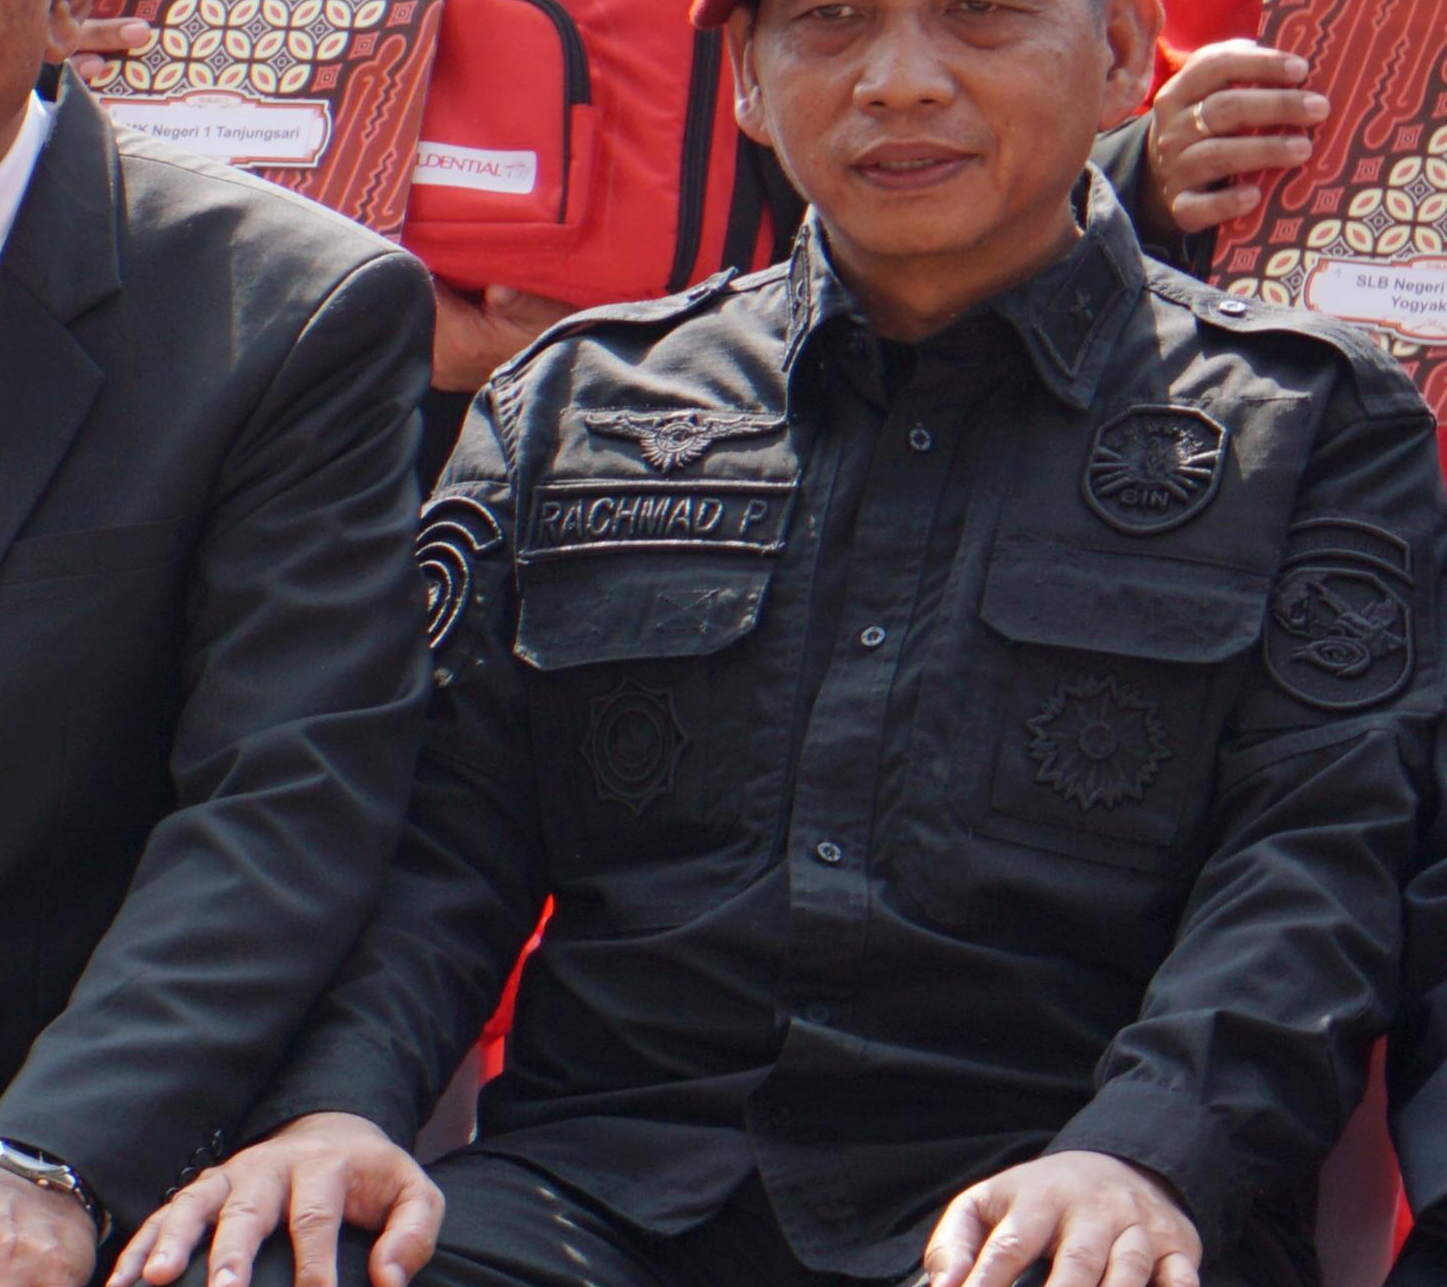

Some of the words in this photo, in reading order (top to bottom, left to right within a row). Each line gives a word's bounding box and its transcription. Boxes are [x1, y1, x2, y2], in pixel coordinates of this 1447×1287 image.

[152, 124, 200, 141] Negeri
[204, 125, 210, 137] 1
[216, 125, 300, 142] Tanjungsari
[1356, 274, 1389, 290] SLB
[1394, 276, 1445, 295] Negeri
[537, 496, 723, 542] RACHMAD
[739, 498, 769, 534] P
